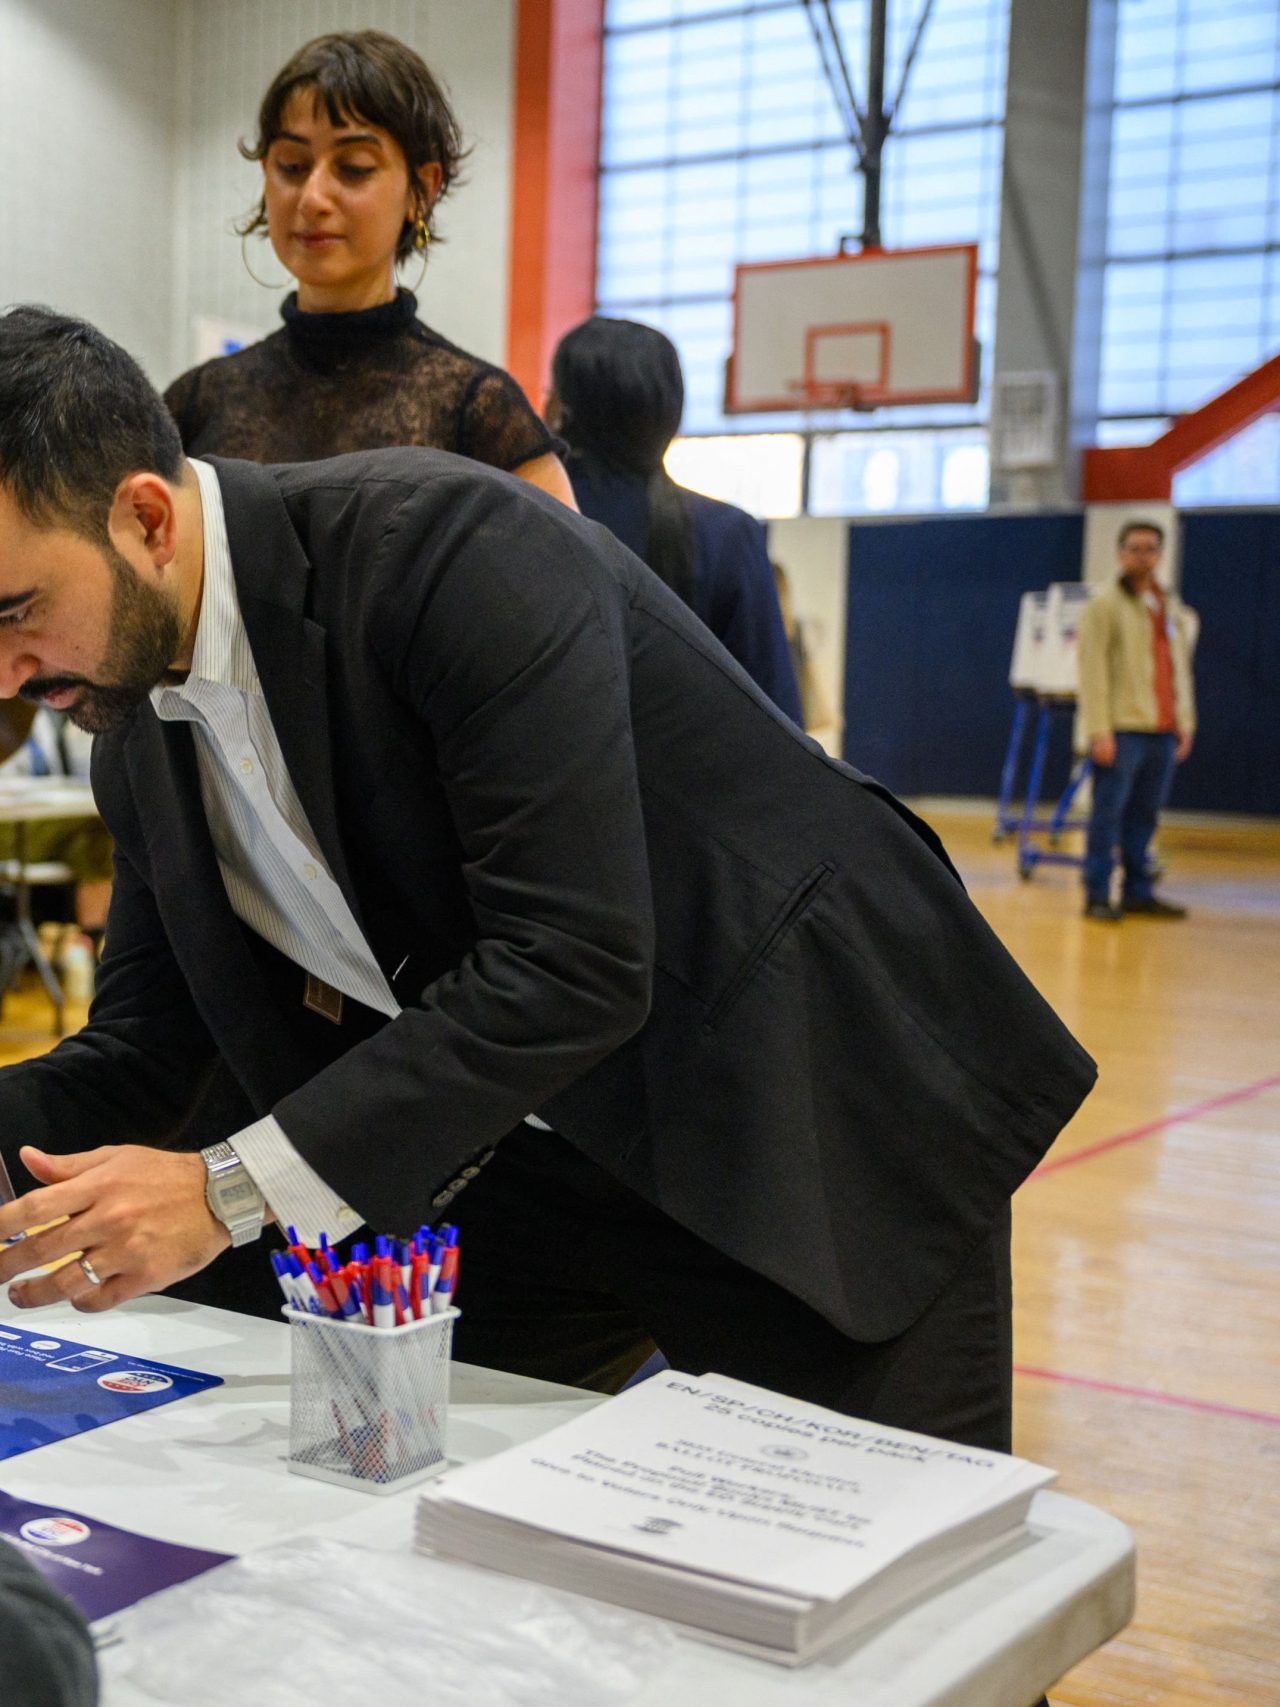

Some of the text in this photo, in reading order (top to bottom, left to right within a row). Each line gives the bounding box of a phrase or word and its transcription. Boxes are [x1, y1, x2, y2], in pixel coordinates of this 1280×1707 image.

[704, 1403, 926, 1463] 25 copies per pack
